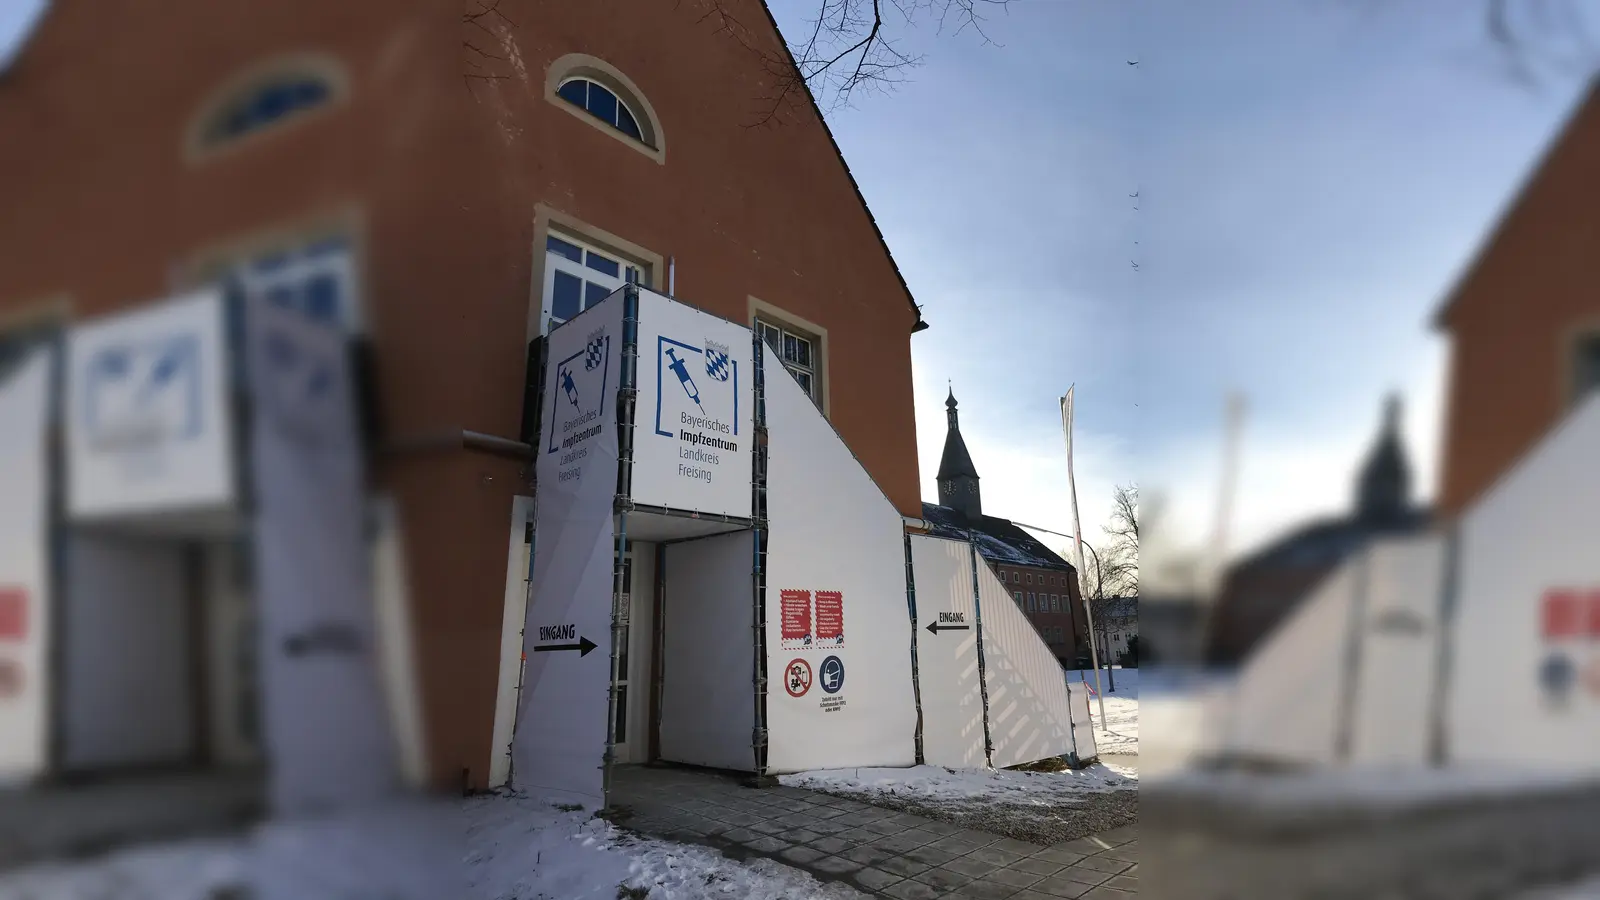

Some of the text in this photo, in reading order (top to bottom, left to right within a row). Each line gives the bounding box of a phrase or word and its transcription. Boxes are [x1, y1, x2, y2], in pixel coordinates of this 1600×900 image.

[680, 411, 730, 434] Bayerisches
[562, 424, 602, 449] Impfzentrum
[680, 429, 738, 452] Impfzentrum
[679, 446, 719, 465] Landkreis
[678, 463, 712, 483] Freising
[939, 611, 964, 623] EINGANG
[539, 623, 576, 641] EINGANG
